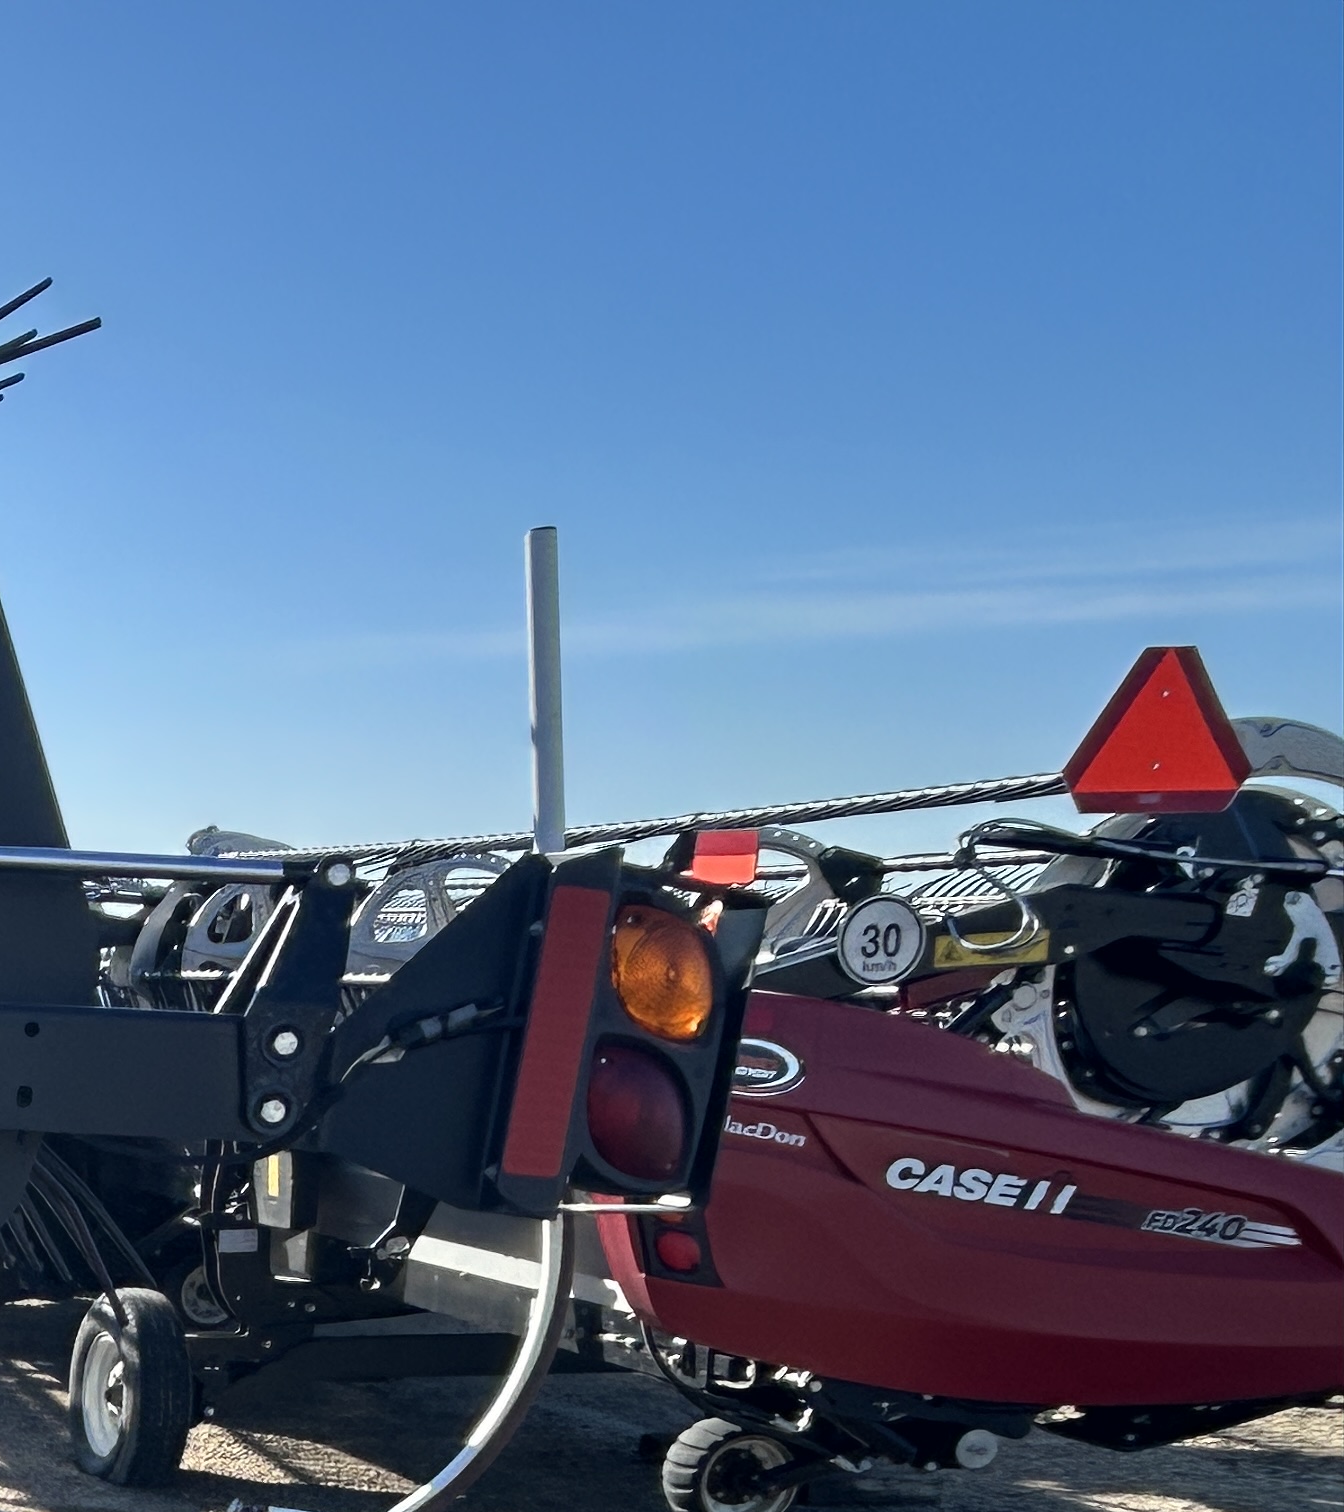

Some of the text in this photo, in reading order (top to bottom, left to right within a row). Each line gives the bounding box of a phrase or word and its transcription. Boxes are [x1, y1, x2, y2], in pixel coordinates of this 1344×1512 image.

[861, 923, 901, 958] 30
[885, 1157, 1027, 1207] CASE
[1145, 1207, 1247, 1241] FD240
